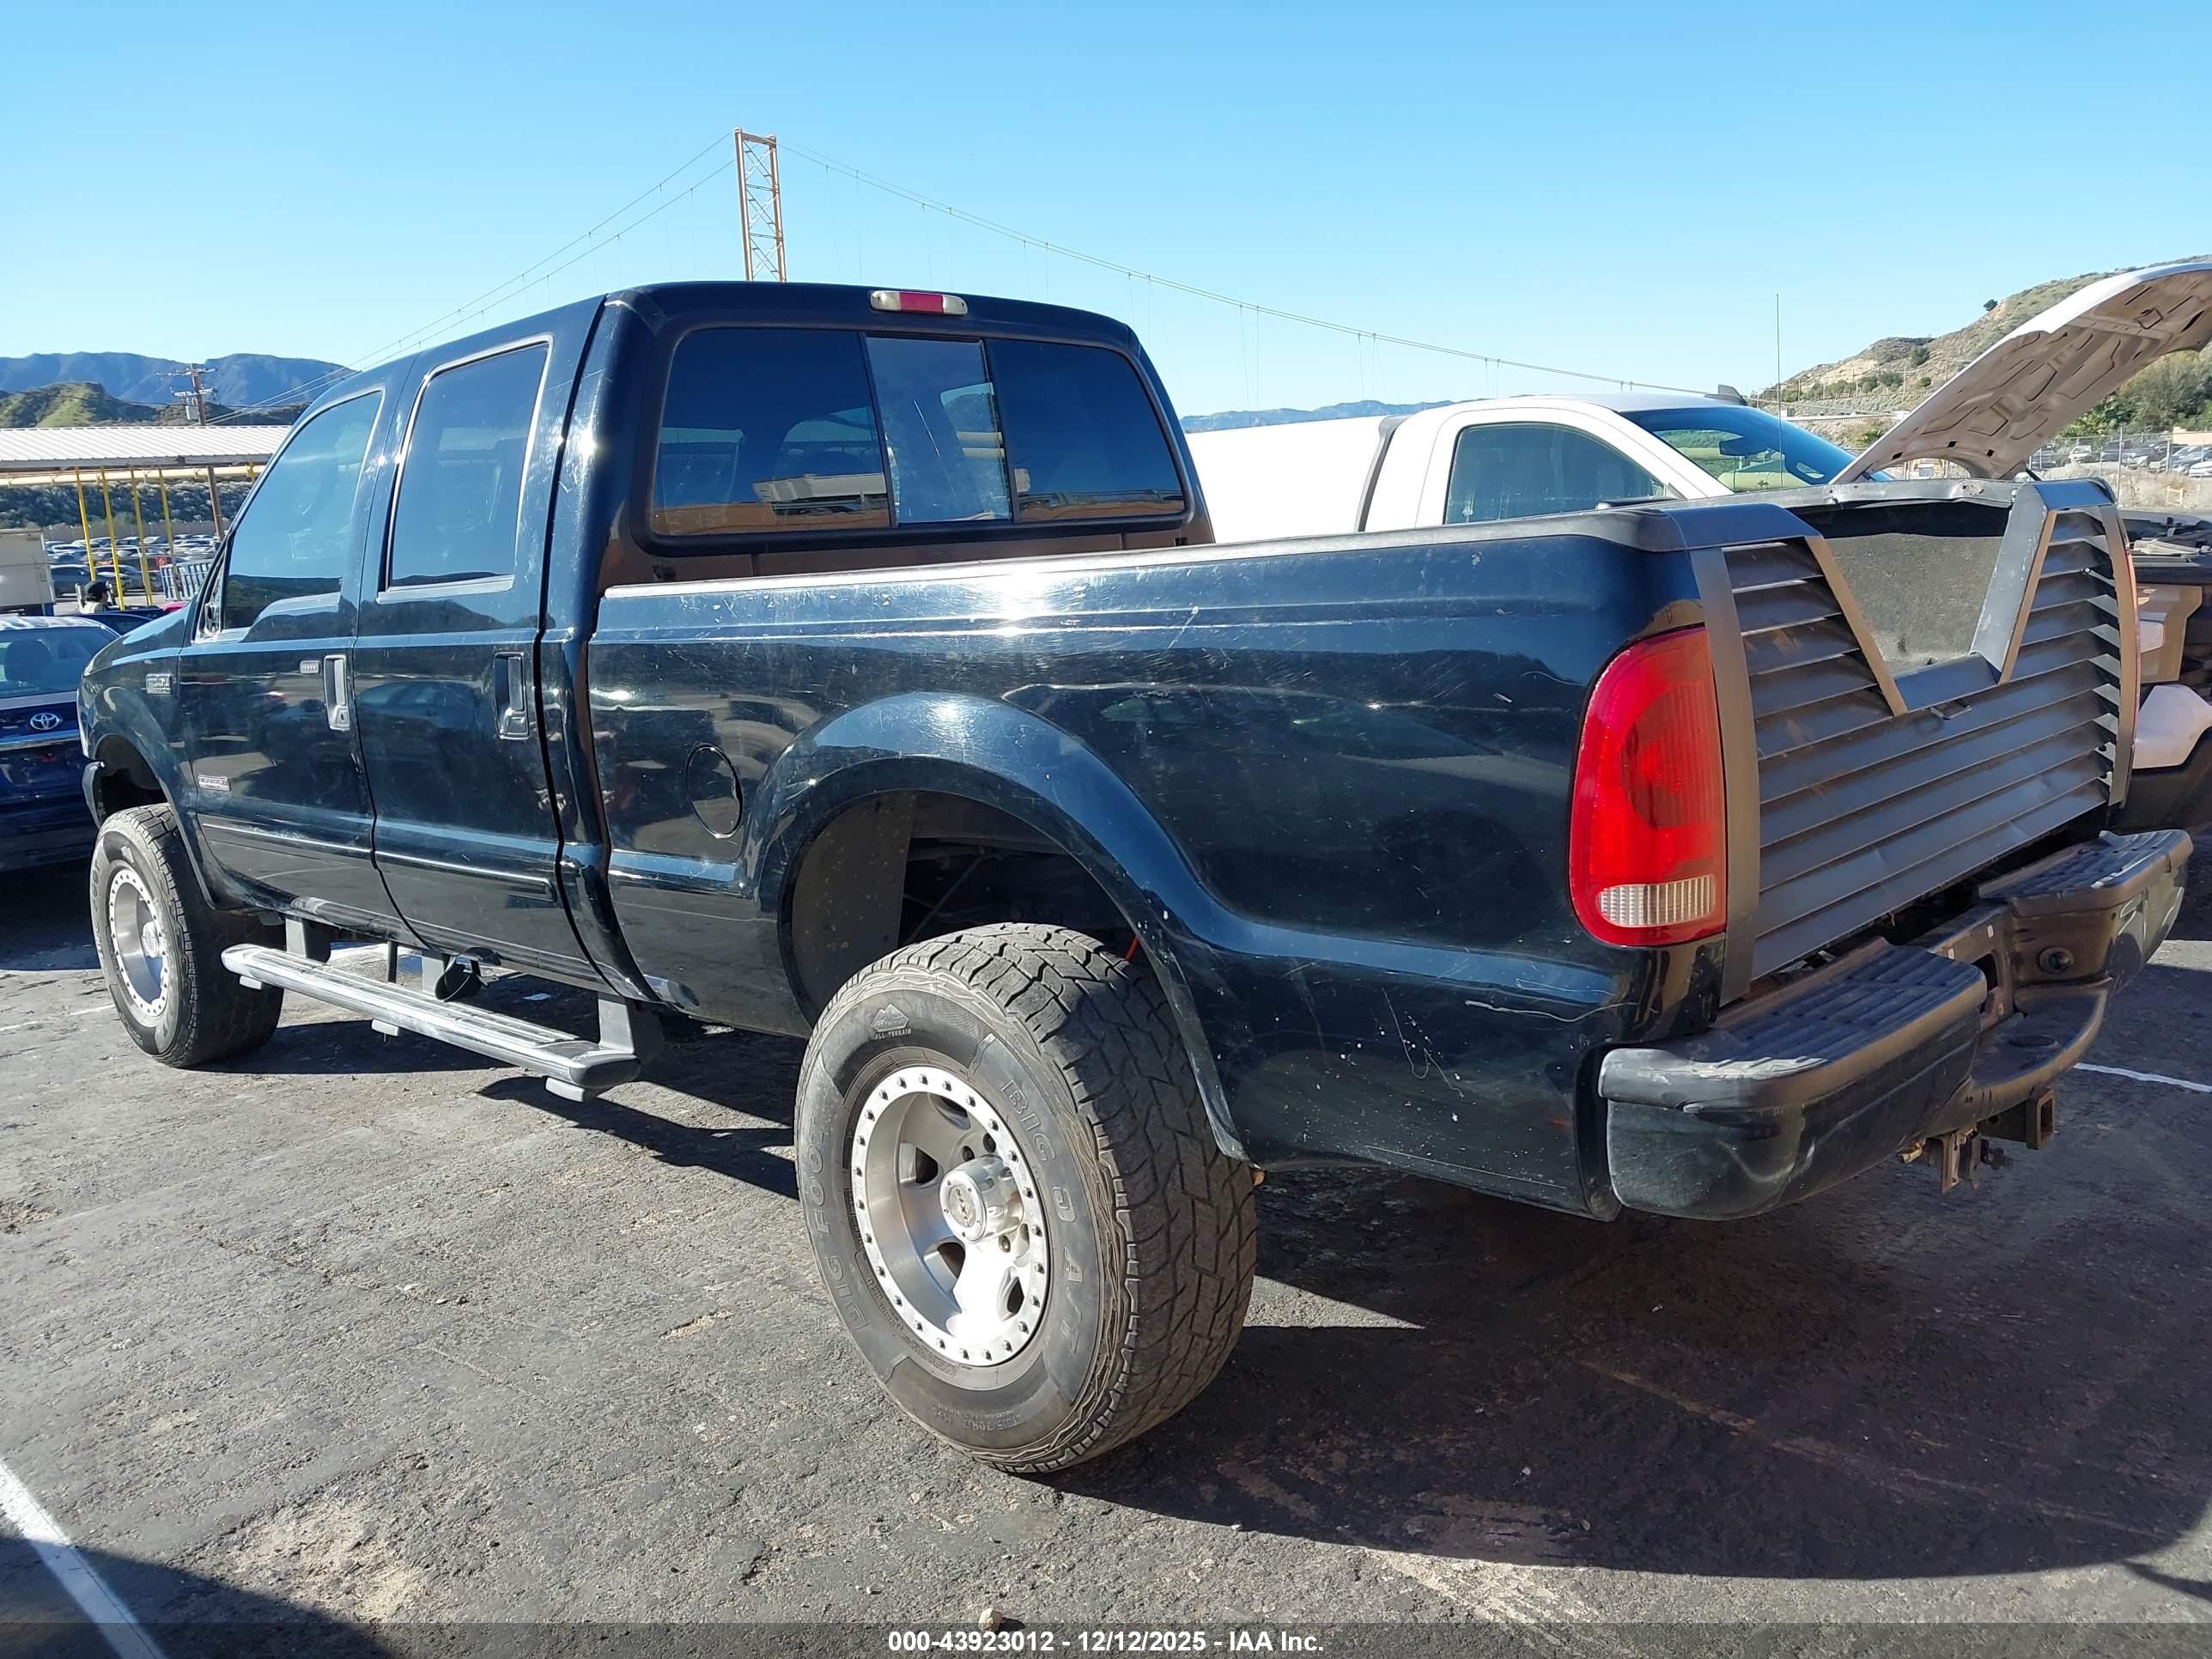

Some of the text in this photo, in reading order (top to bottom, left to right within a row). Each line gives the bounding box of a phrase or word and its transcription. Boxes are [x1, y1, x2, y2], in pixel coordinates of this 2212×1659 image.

[1000, 1079, 1057, 1162] BIG
[808, 1113, 832, 1237] FOOT
[824, 1255, 869, 1332] BIG
